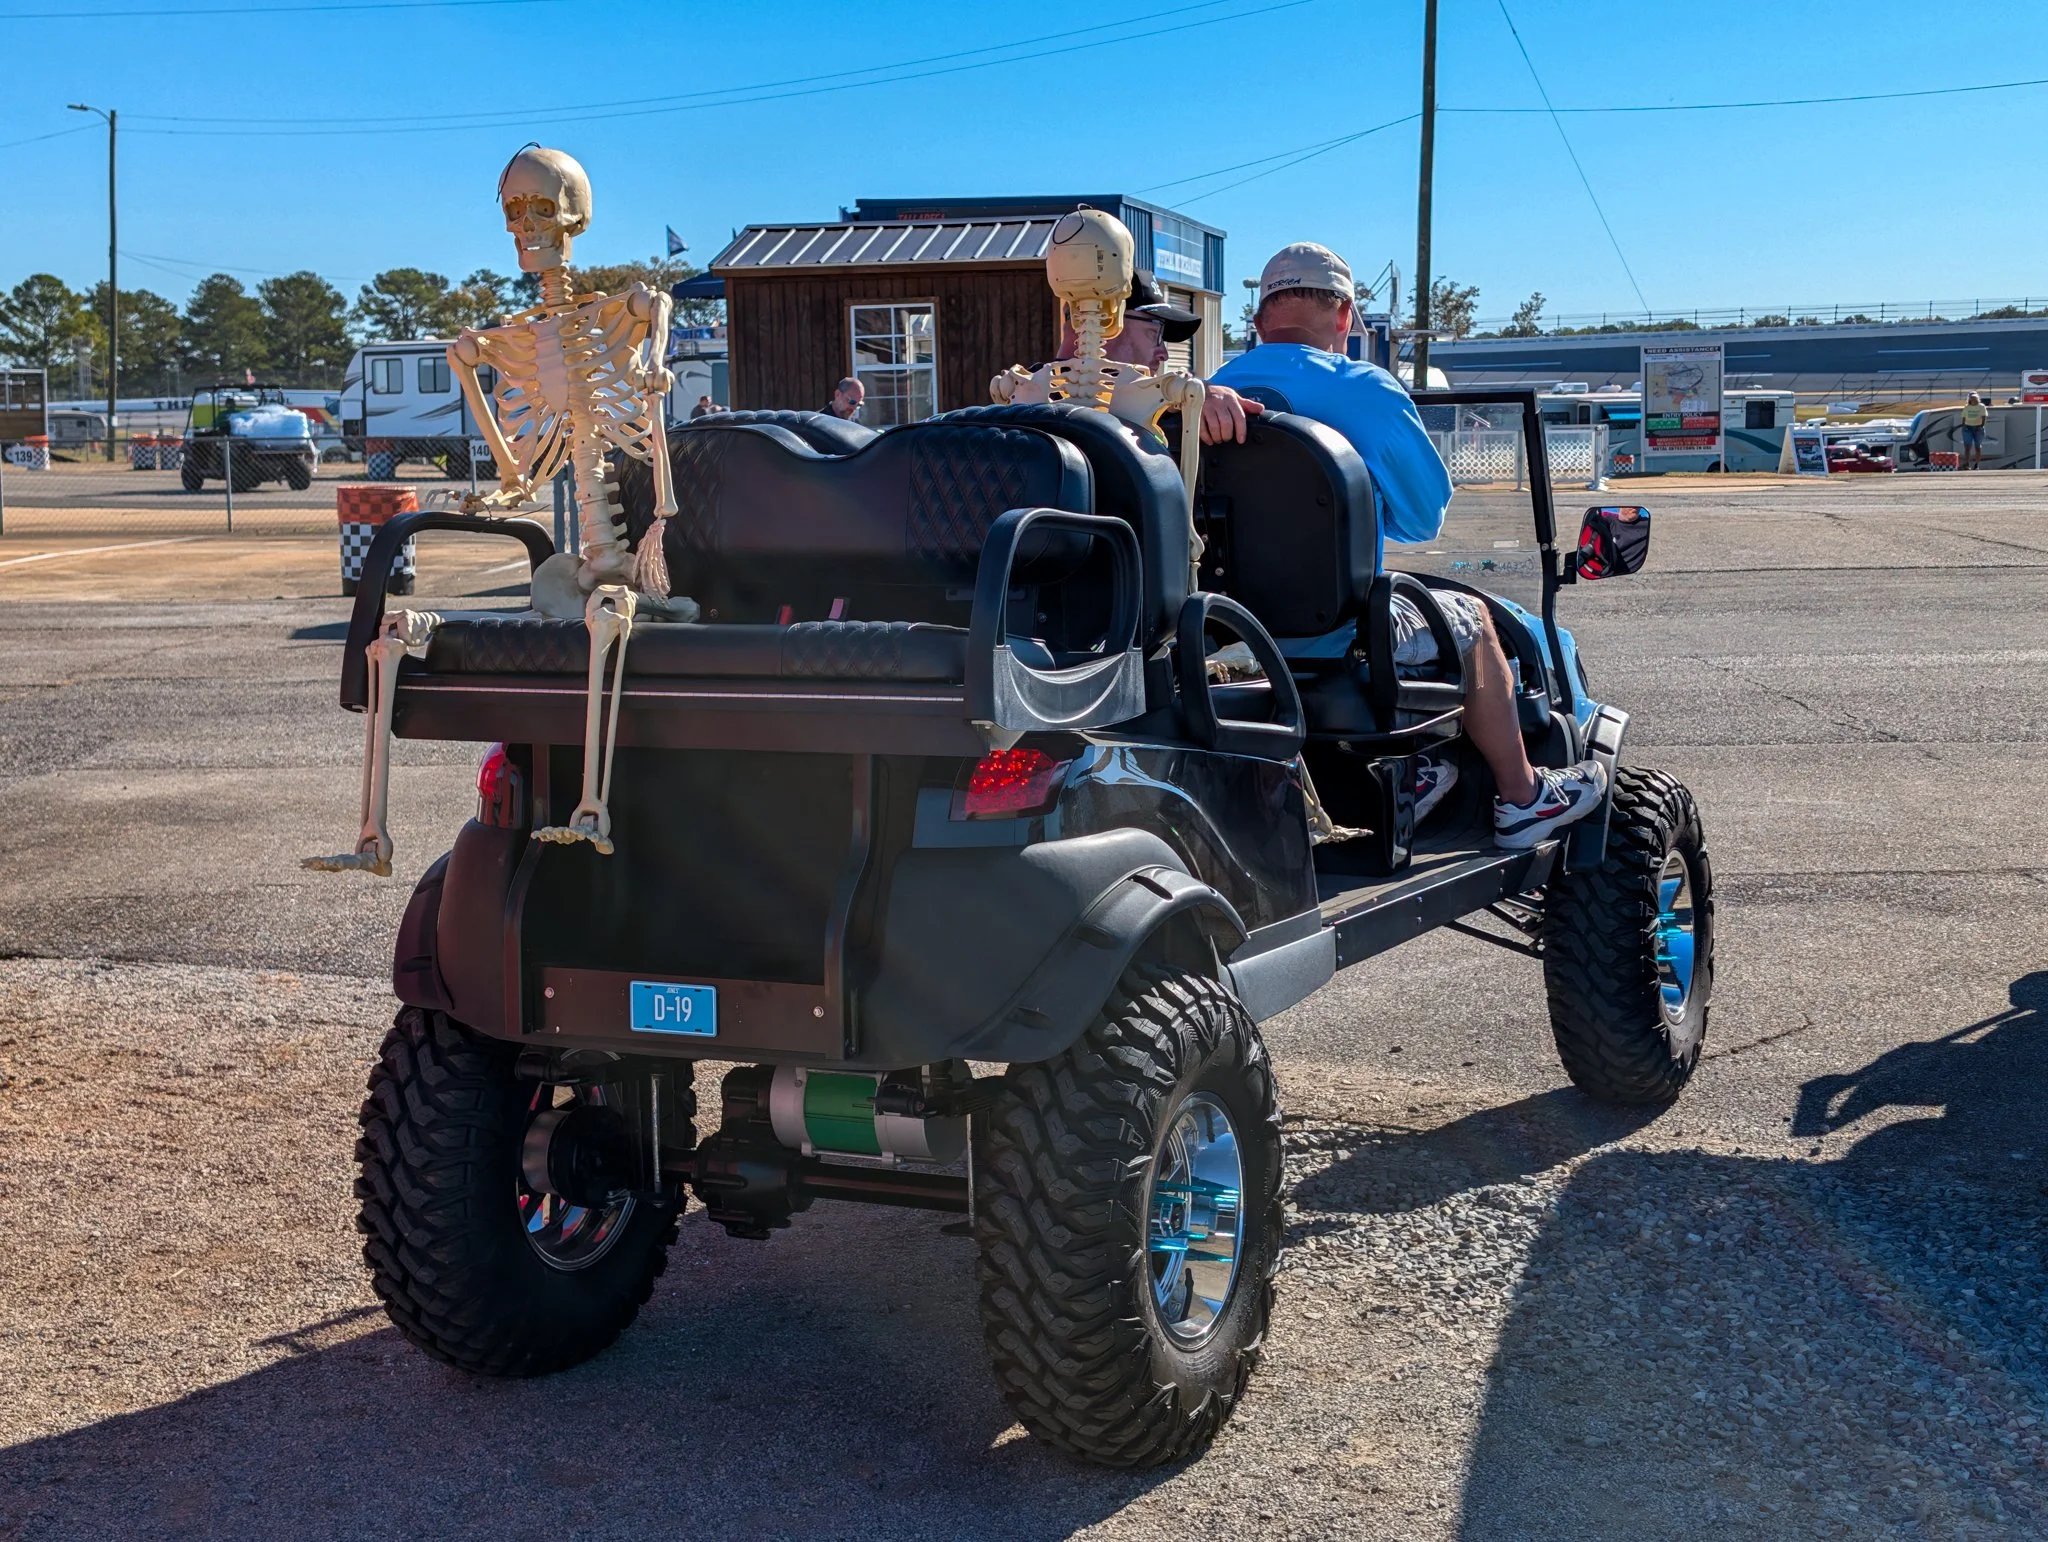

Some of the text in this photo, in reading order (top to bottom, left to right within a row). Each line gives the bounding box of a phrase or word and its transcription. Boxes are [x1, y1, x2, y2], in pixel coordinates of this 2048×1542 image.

[15, 451, 33, 463] 139
[472, 445, 490, 457] 140
[654, 994, 692, 1023] D-19
